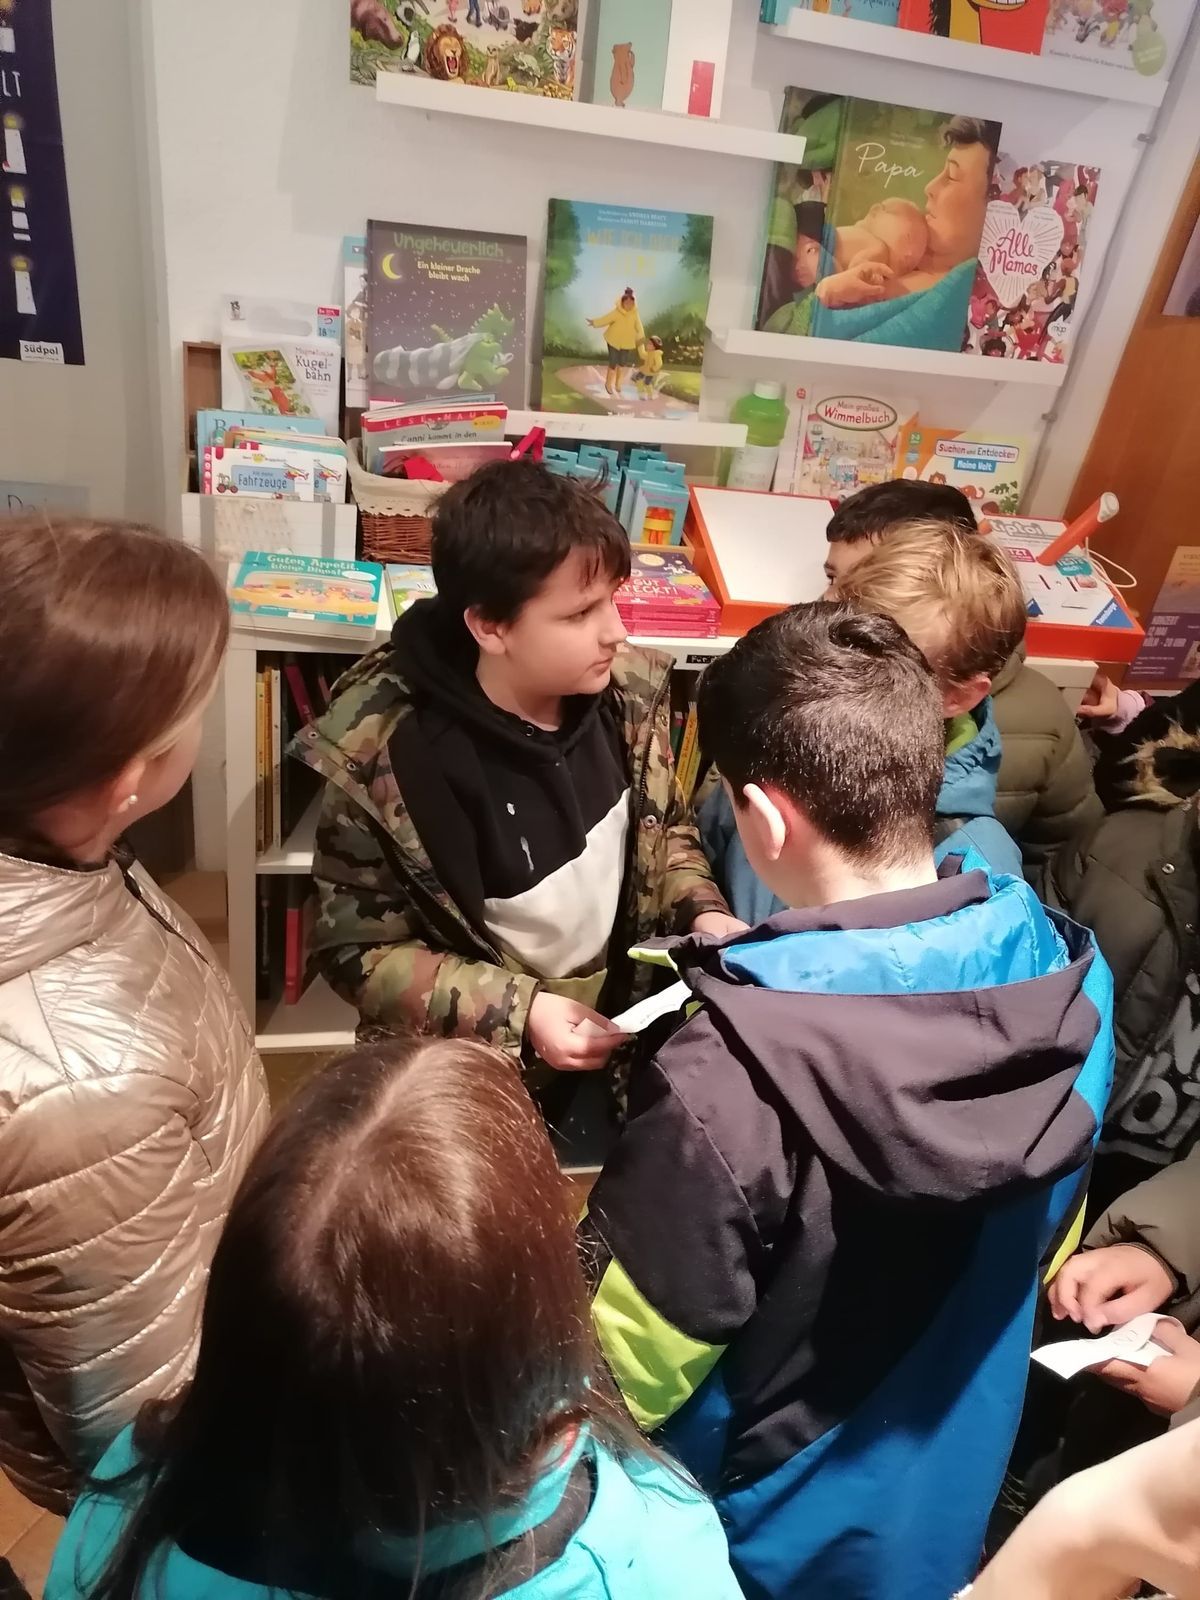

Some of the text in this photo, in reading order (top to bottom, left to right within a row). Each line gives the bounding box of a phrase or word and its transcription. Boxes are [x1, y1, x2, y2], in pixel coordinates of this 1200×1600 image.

[855, 142, 925, 189] Papa
[393, 231, 504, 257] Ungeheuerlich
[996, 228, 1035, 259] Alle
[417, 261, 481, 275] Ein kleiner Drache
[987, 246, 1038, 277] Mamas
[428, 270, 470, 282] bleibt wach
[24, 344, 59, 355] Südpol
[295, 355, 332, 370] Kugel-
[305, 368, 332, 382] bahn
[837, 401, 854, 409] Mein
[824, 404, 891, 424] Wimmelbuch
[464, 430, 478, 438] den
[238, 473, 288, 490] Fahrzeuge
[266, 554, 305, 567] Guten
[633, 578, 660, 586] GUT
